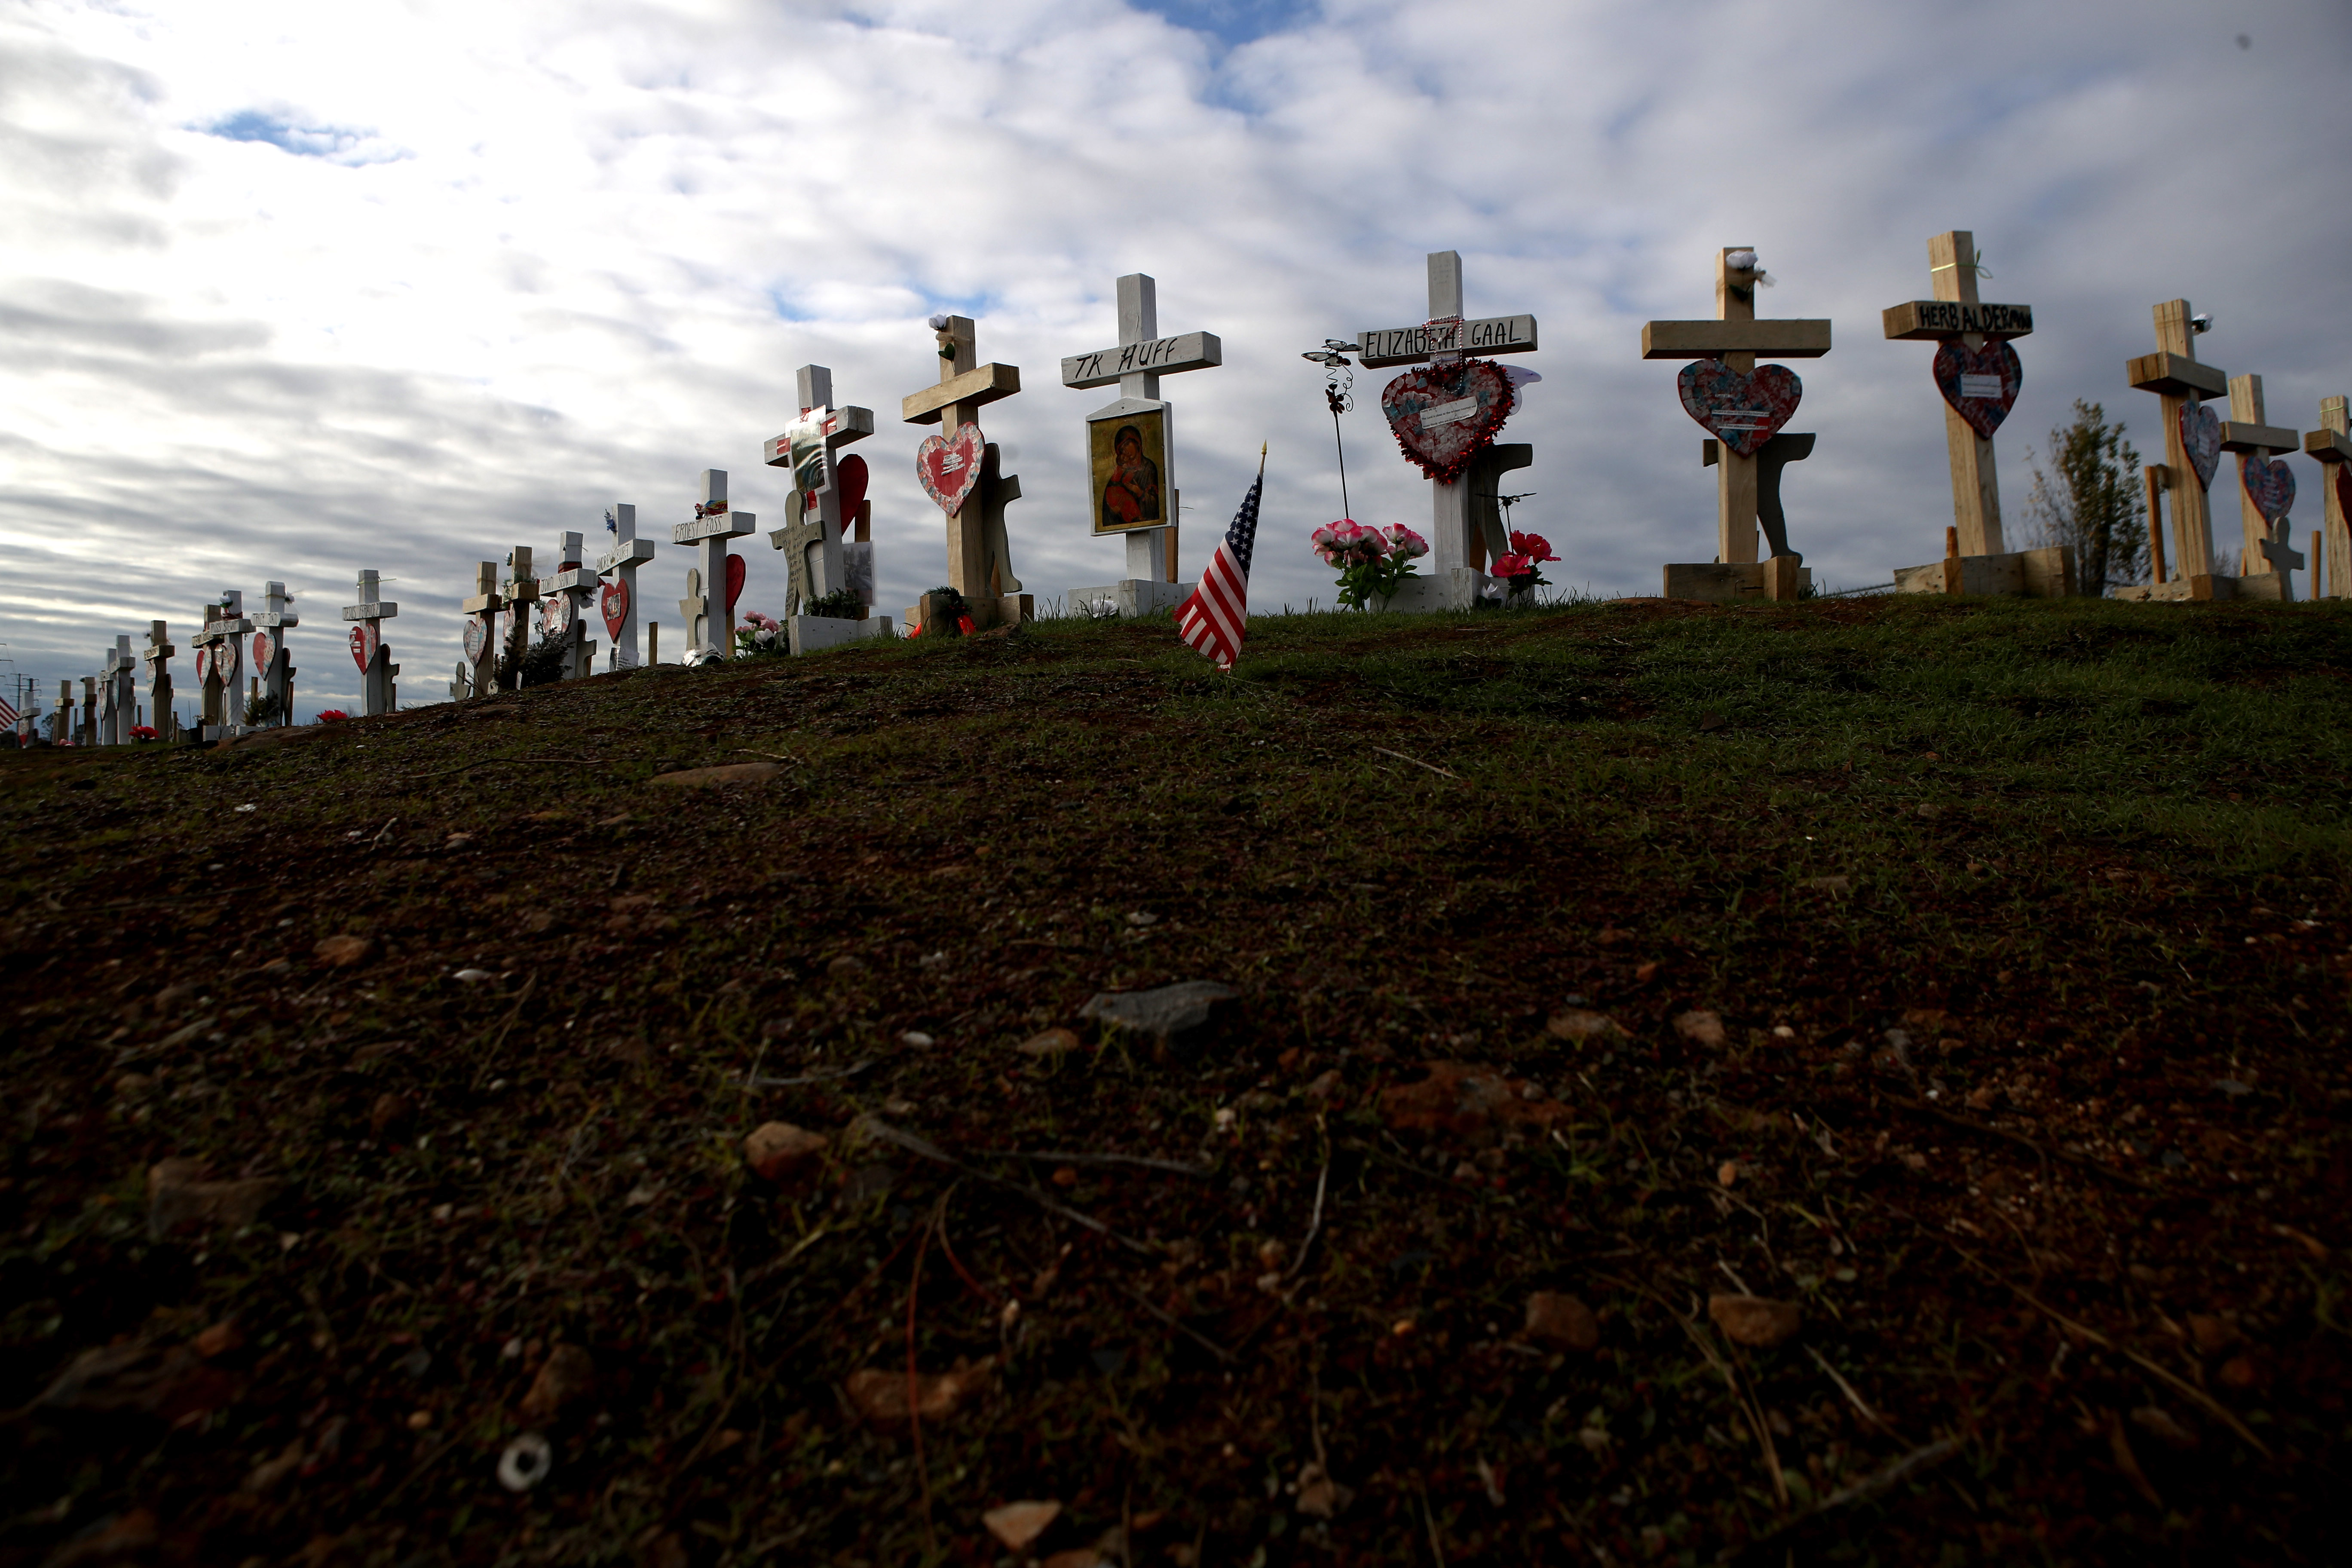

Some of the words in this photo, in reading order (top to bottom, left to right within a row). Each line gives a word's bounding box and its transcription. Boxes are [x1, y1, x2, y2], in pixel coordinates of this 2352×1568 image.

[1920, 303, 1959, 330] HERB
[1365, 326, 1456, 358] ELIZABETH
[1472, 320, 1522, 346] GAAL
[1075, 354, 1103, 379] TK
[1118, 338, 1178, 372] HUFF
[675, 520, 701, 542] ERNEST
[705, 515, 722, 534] FOSS
[616, 543, 630, 562] BURT
[541, 576, 554, 592] JOHN
[343, 606, 356, 620] JESUS
